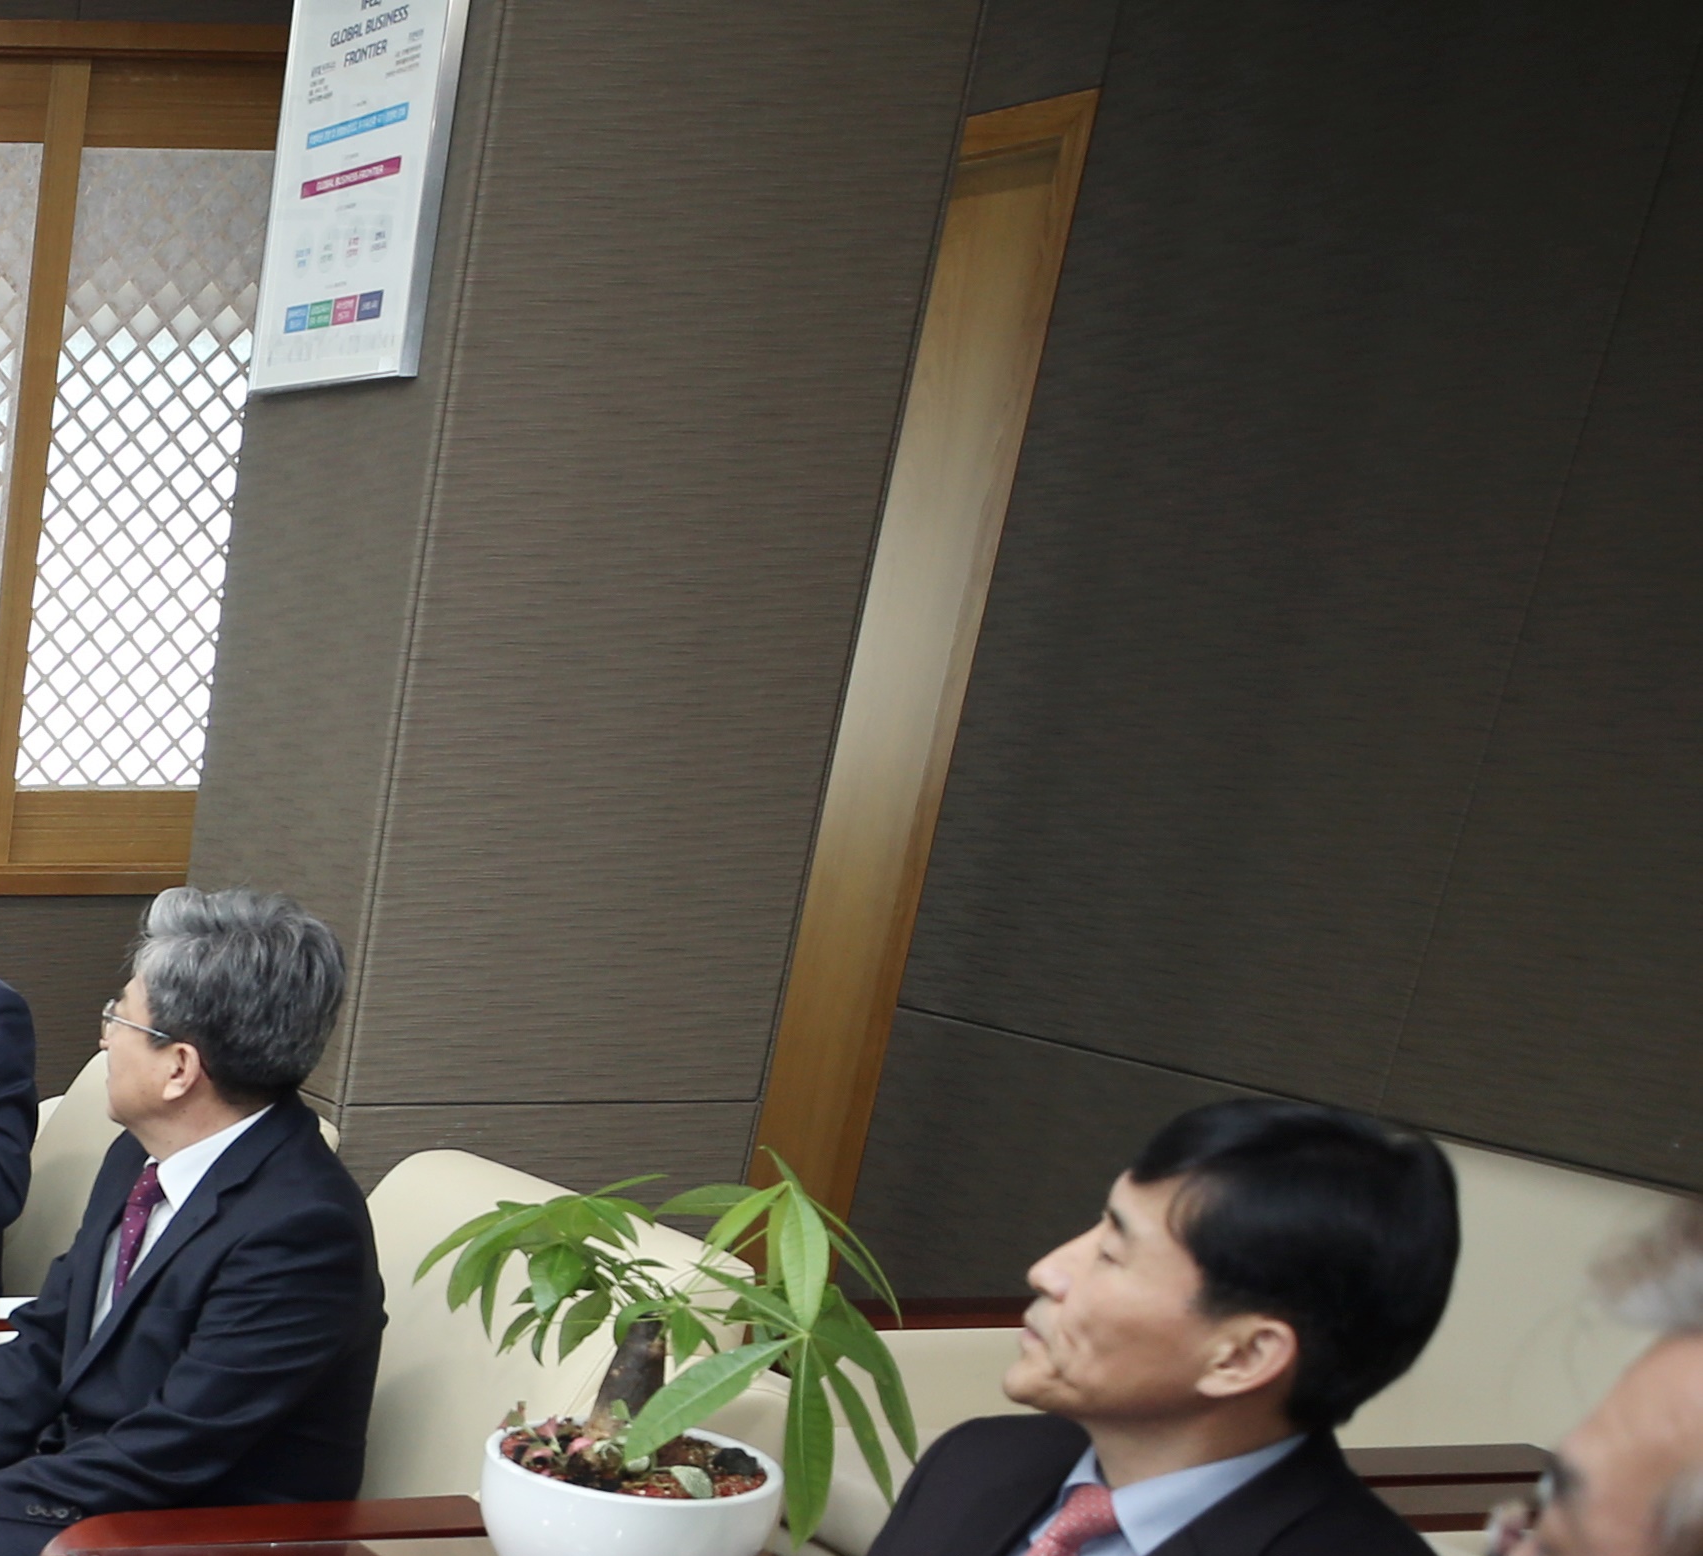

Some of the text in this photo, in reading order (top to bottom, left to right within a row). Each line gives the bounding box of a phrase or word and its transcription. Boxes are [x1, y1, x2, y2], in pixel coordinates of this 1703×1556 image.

[330, 4, 409, 47] GLOBAL BUSINESS
[344, 39, 388, 67] FRONTIER
